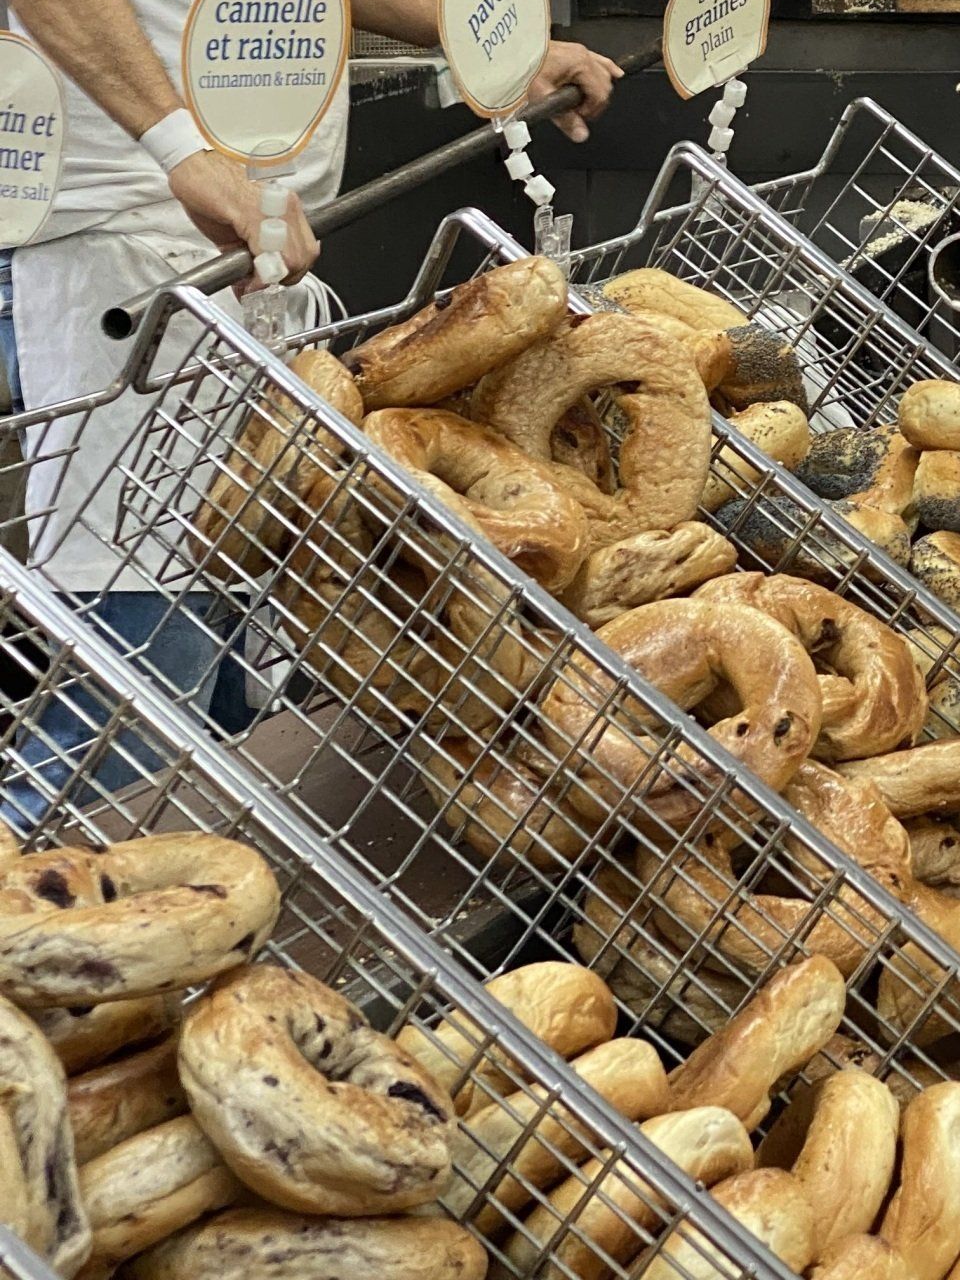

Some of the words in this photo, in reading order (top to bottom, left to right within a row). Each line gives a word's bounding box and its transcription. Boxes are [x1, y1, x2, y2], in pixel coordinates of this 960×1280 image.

[206, 33, 231, 61] et
[237, 29, 326, 60] raisins
[482, 3, 518, 62] poppy
[701, 26, 734, 61] plain
[199, 70, 271, 89] cinnamon
[285, 67, 326, 86] raisin
[32, 112, 56, 137] et
[21, 182, 49, 201] salt
